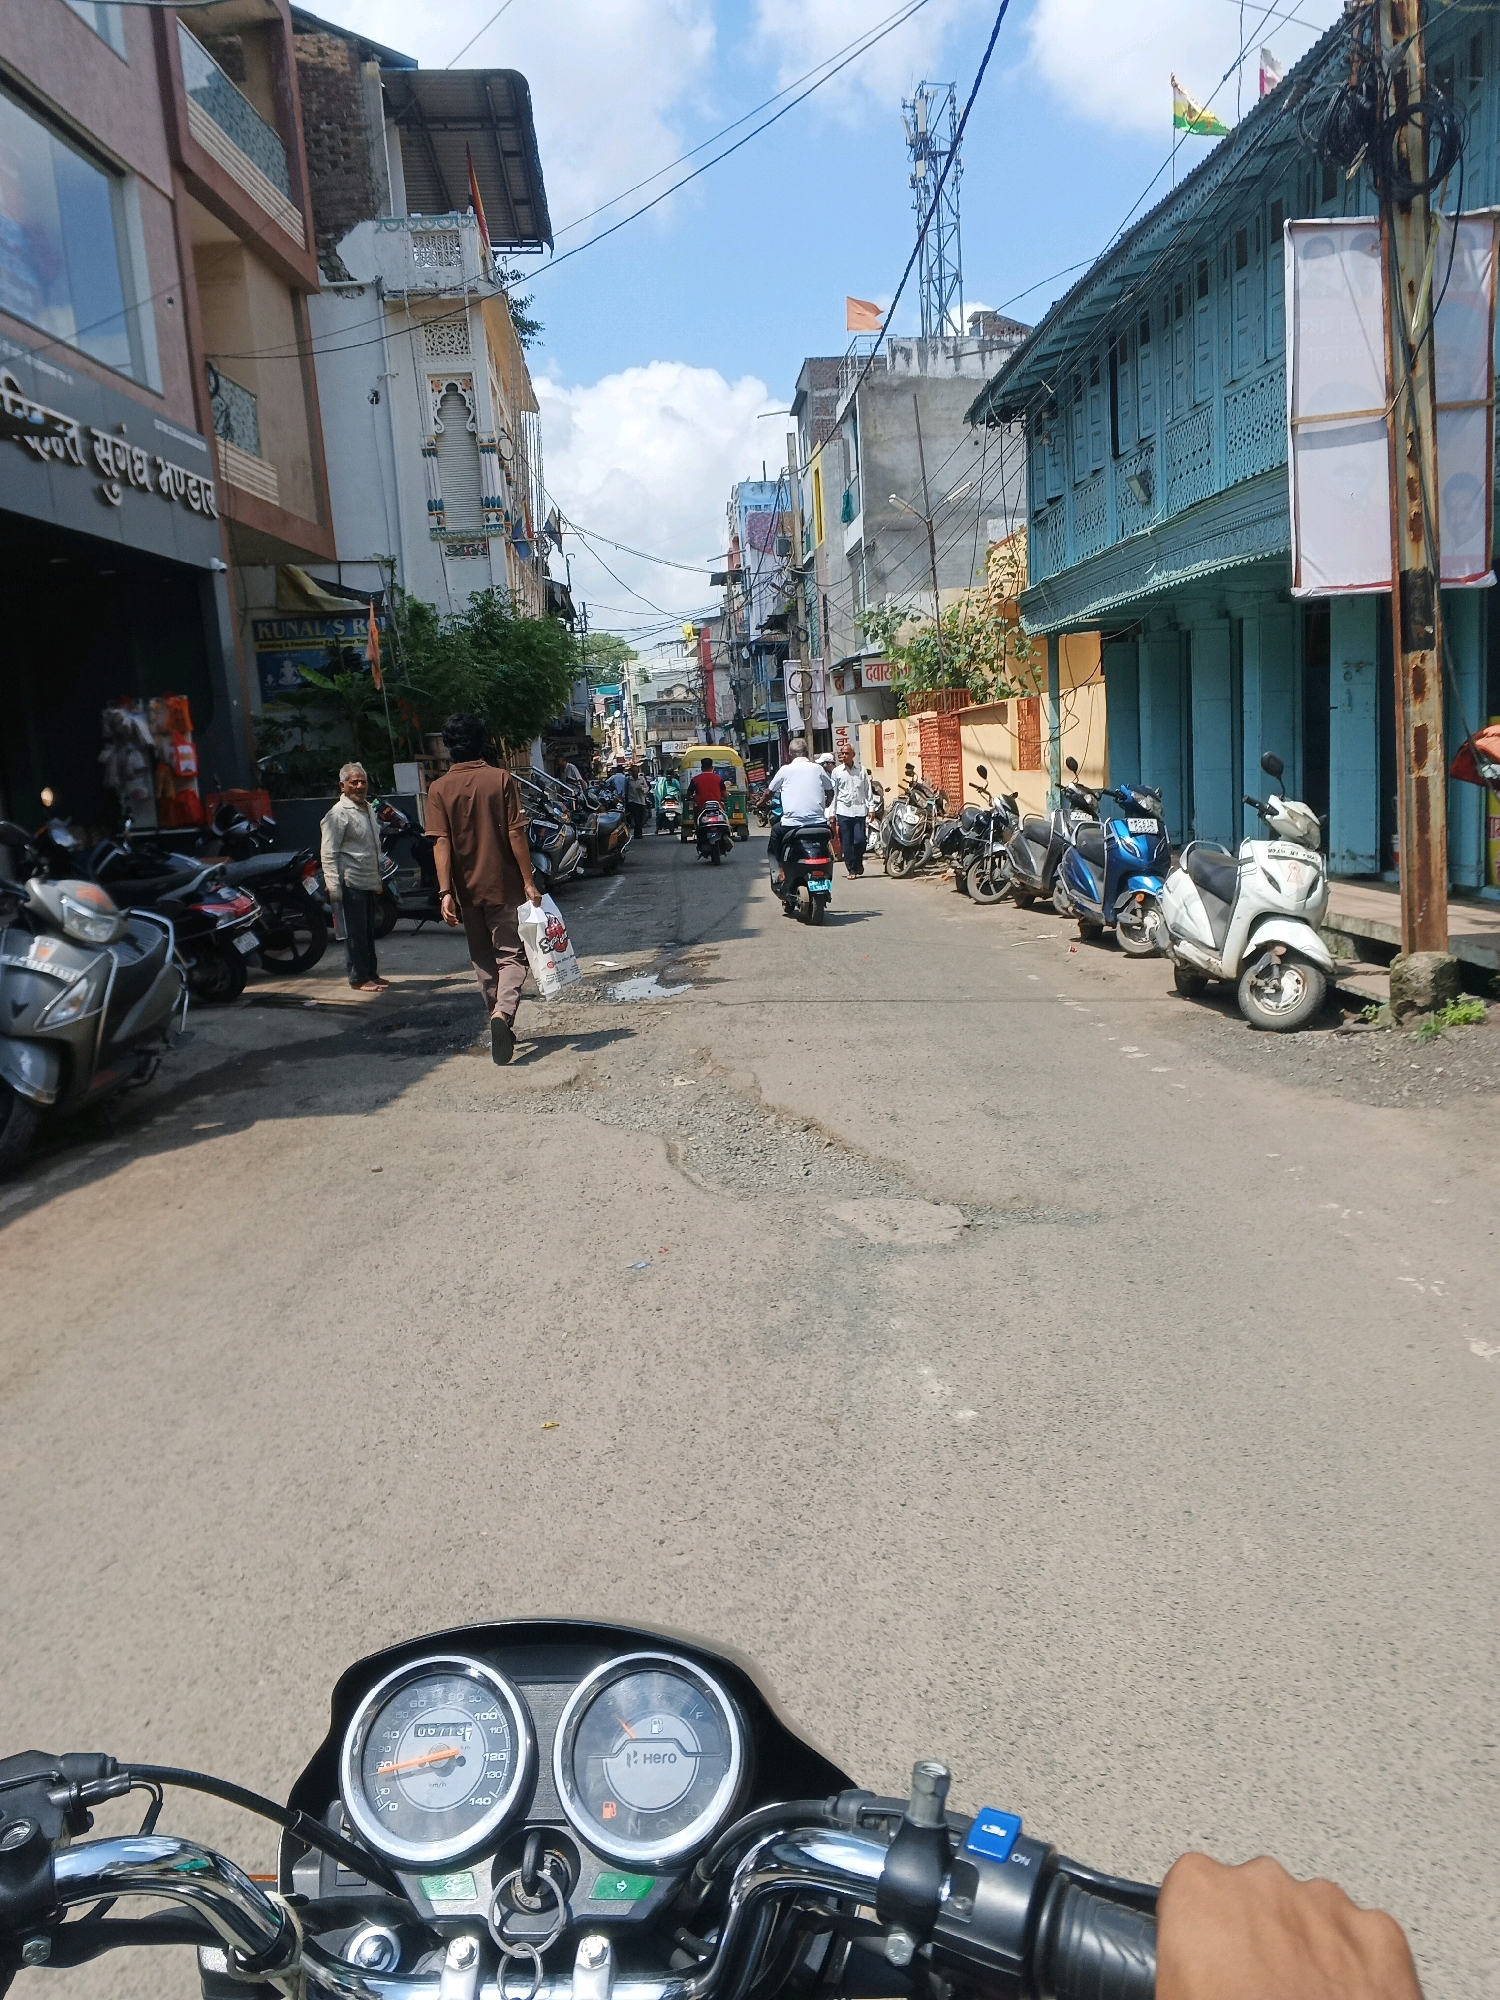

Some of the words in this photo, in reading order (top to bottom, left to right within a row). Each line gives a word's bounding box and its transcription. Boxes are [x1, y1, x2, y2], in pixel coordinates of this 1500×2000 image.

[257, 618, 345, 639] KUNAL'S
[447, 1692, 465, 1701] 80
[468, 1695, 482, 1703] 90
[409, 1700, 427, 1708] 60
[474, 1712, 498, 1720] 100
[695, 1711, 704, 1720] F
[382, 1730, 400, 1739] 40
[489, 1726, 503, 1734] 110
[377, 1745, 392, 1753] 30
[482, 1752, 506, 1761] 120
[643, 1751, 677, 1765] Hero
[376, 1760, 392, 1769] 20
[484, 1771, 502, 1779] 130
[379, 1787, 391, 1795] 10
[468, 1797, 492, 1805] 140
[389, 1802, 399, 1811] 0
[627, 1818, 641, 1835] N
[1011, 1852, 1031, 1867] ON
